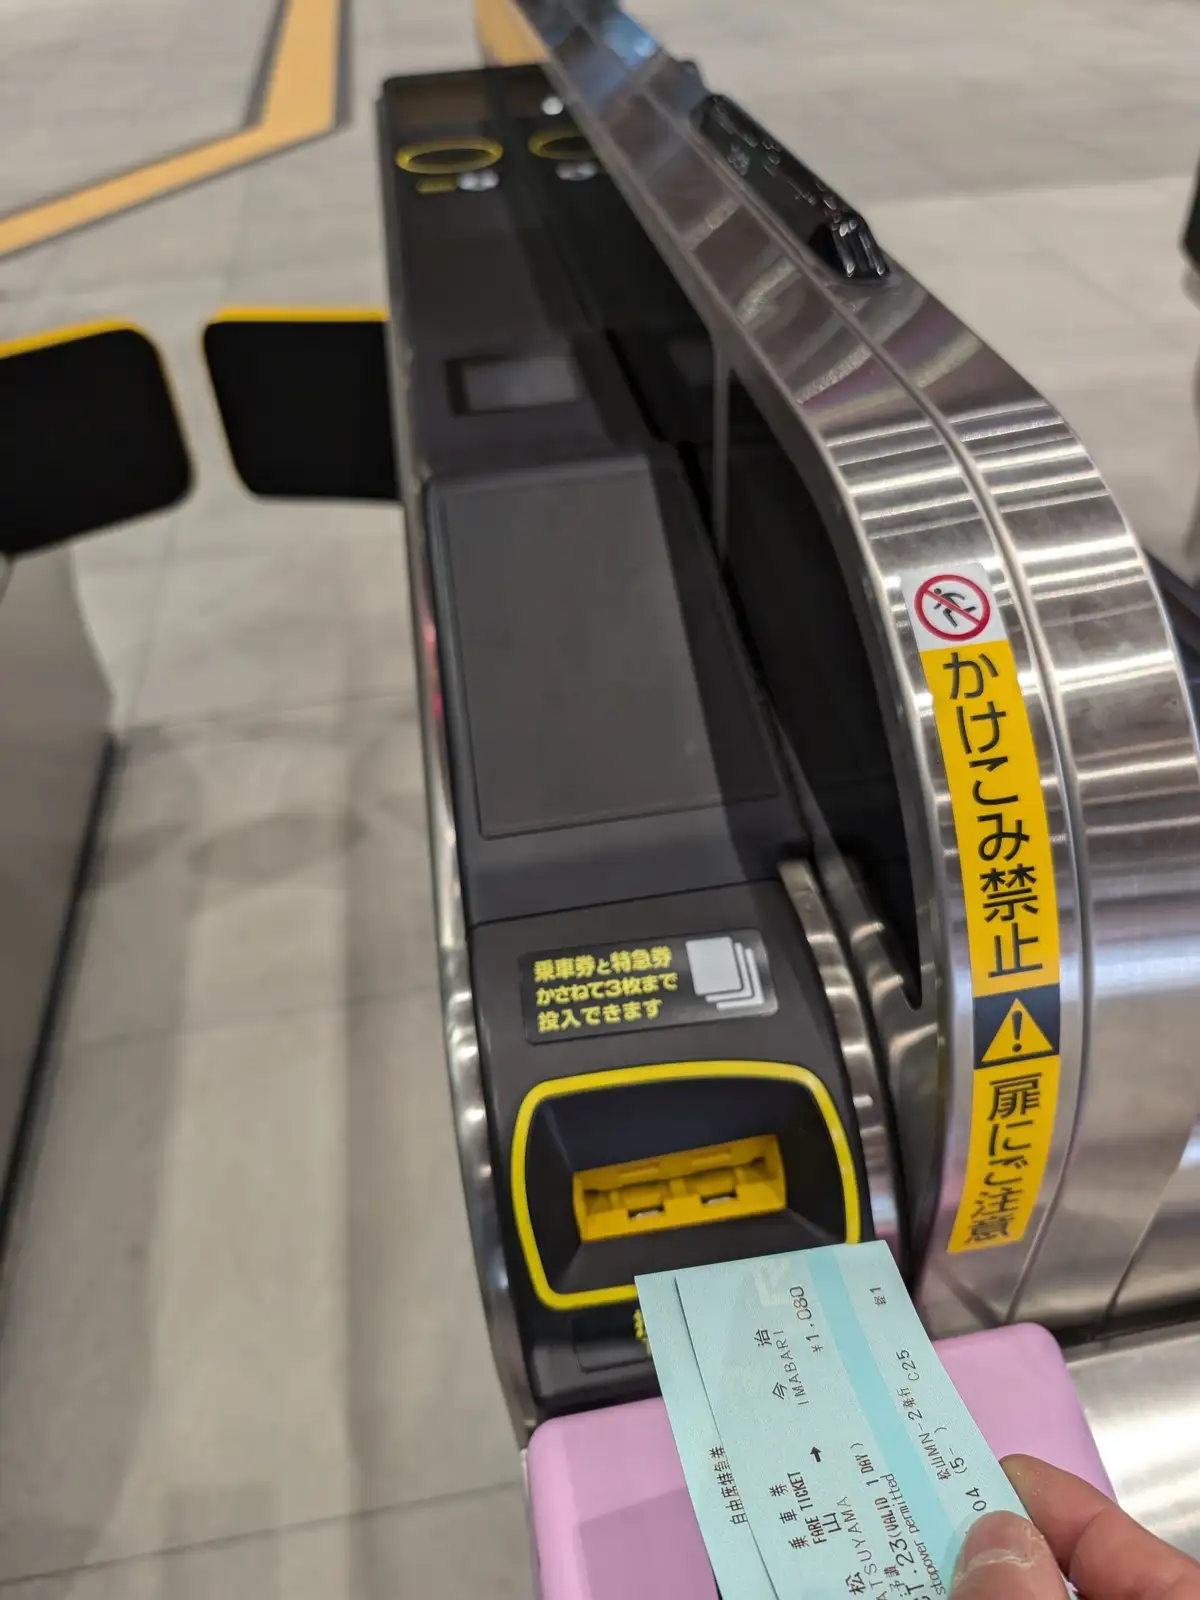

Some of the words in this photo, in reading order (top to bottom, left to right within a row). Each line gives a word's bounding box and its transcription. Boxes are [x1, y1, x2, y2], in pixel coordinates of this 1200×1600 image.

[942, 651, 1043, 979] かけこみ禁止
[533, 945, 673, 983] 乗車券と特急券
[535, 972, 679, 1006] かさねて3枚まで
[537, 998, 663, 1033] 投入できます
[964, 1072, 1042, 1244] 扉にご注意
[773, 1330, 809, 1405] IMABARI
[896, 1349, 920, 1382] C25
[787, 1471, 814, 1511] TICKET
[880, 1473, 920, 1534] permitted
[769, 1484, 811, 1549] 乗車券
[805, 1515, 827, 1545] FARE
[914, 1540, 946, 1596] stopover
